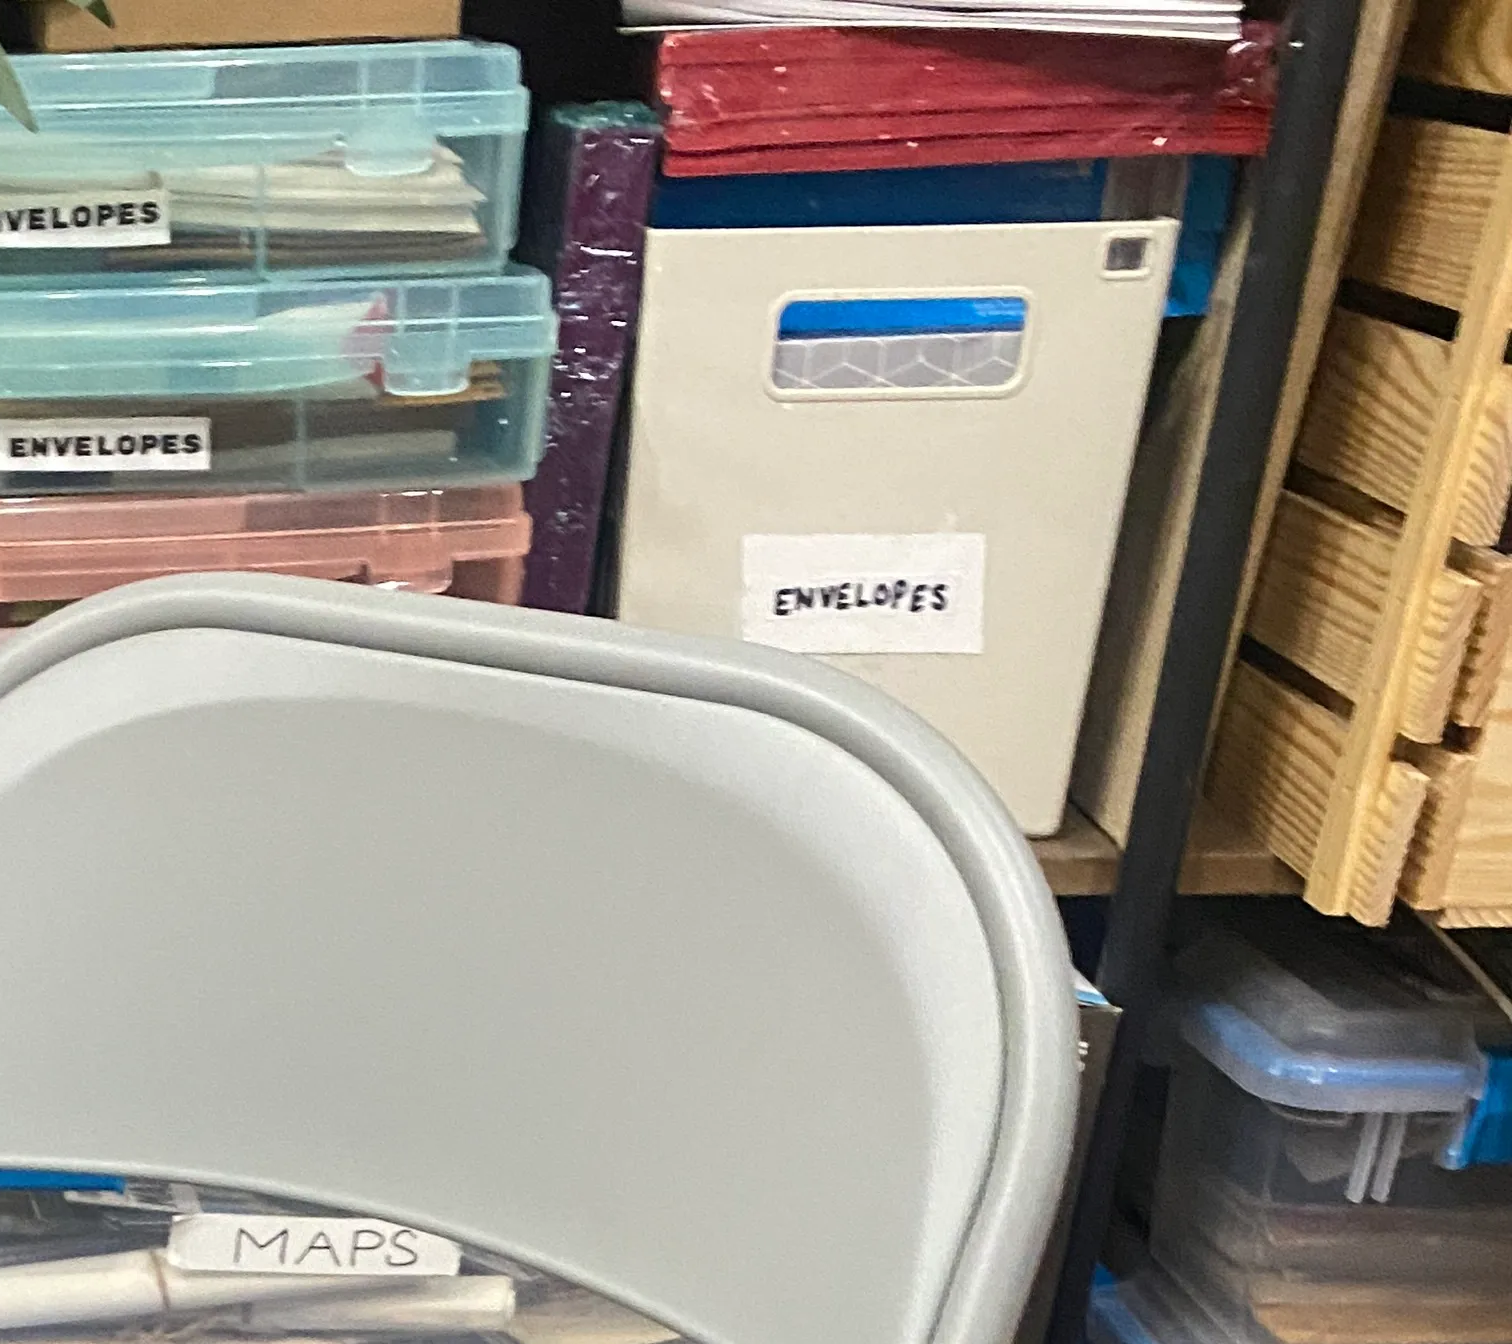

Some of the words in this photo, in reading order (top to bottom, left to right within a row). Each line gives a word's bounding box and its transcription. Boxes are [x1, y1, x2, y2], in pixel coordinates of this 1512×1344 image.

[10, 433, 202, 458] ENVELOPES
[773, 579, 948, 616] ENVELOPES
[233, 1227, 419, 1268] MAPS
